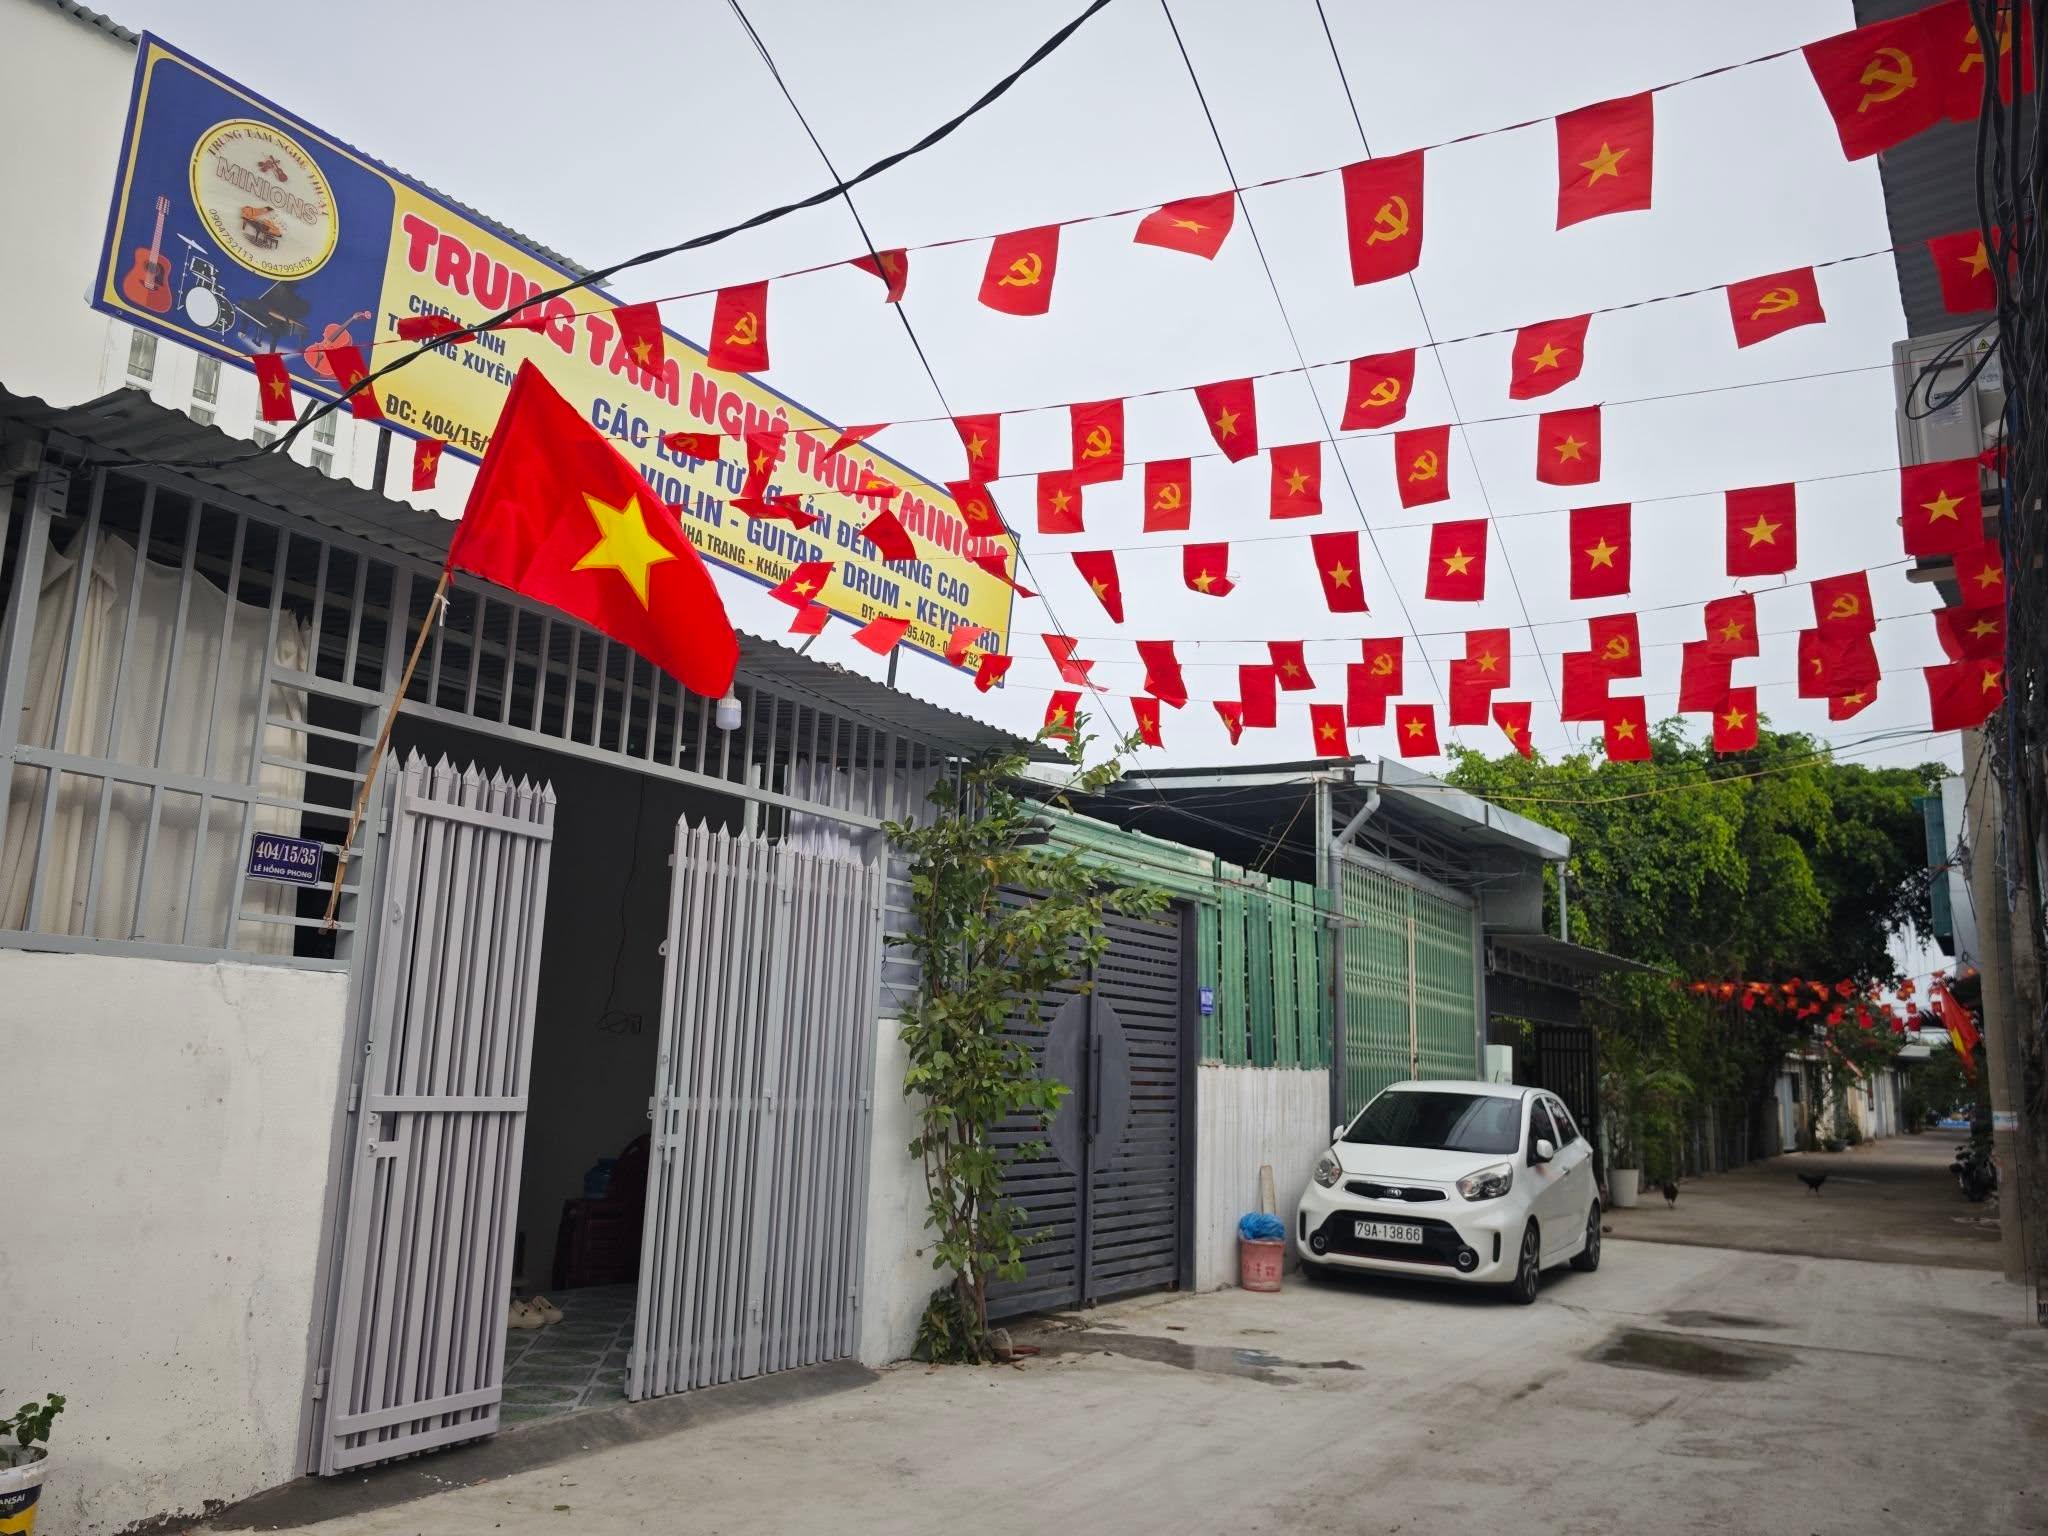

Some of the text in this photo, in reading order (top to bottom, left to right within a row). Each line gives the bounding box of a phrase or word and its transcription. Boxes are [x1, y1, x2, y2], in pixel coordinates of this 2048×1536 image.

[215, 156, 318, 226] MINIONS
[403, 213, 576, 354] TRUNG
[385, 393, 417, 424] ĐC:
[707, 533, 746, 565] TRANG
[592, 398, 648, 449] CÁC
[716, 457, 747, 494] TỪ
[937, 571, 970, 607] CAO
[641, 463, 724, 528] VIOLIN
[746, 517, 824, 562] GUITAR
[842, 561, 900, 609] DRUM
[253, 863, 262, 872] LÊ
[286, 868, 313, 879] PHONG
[255, 841, 317, 866] 404/15/35
[1356, 1222, 1421, 1242] 79A-138.66
